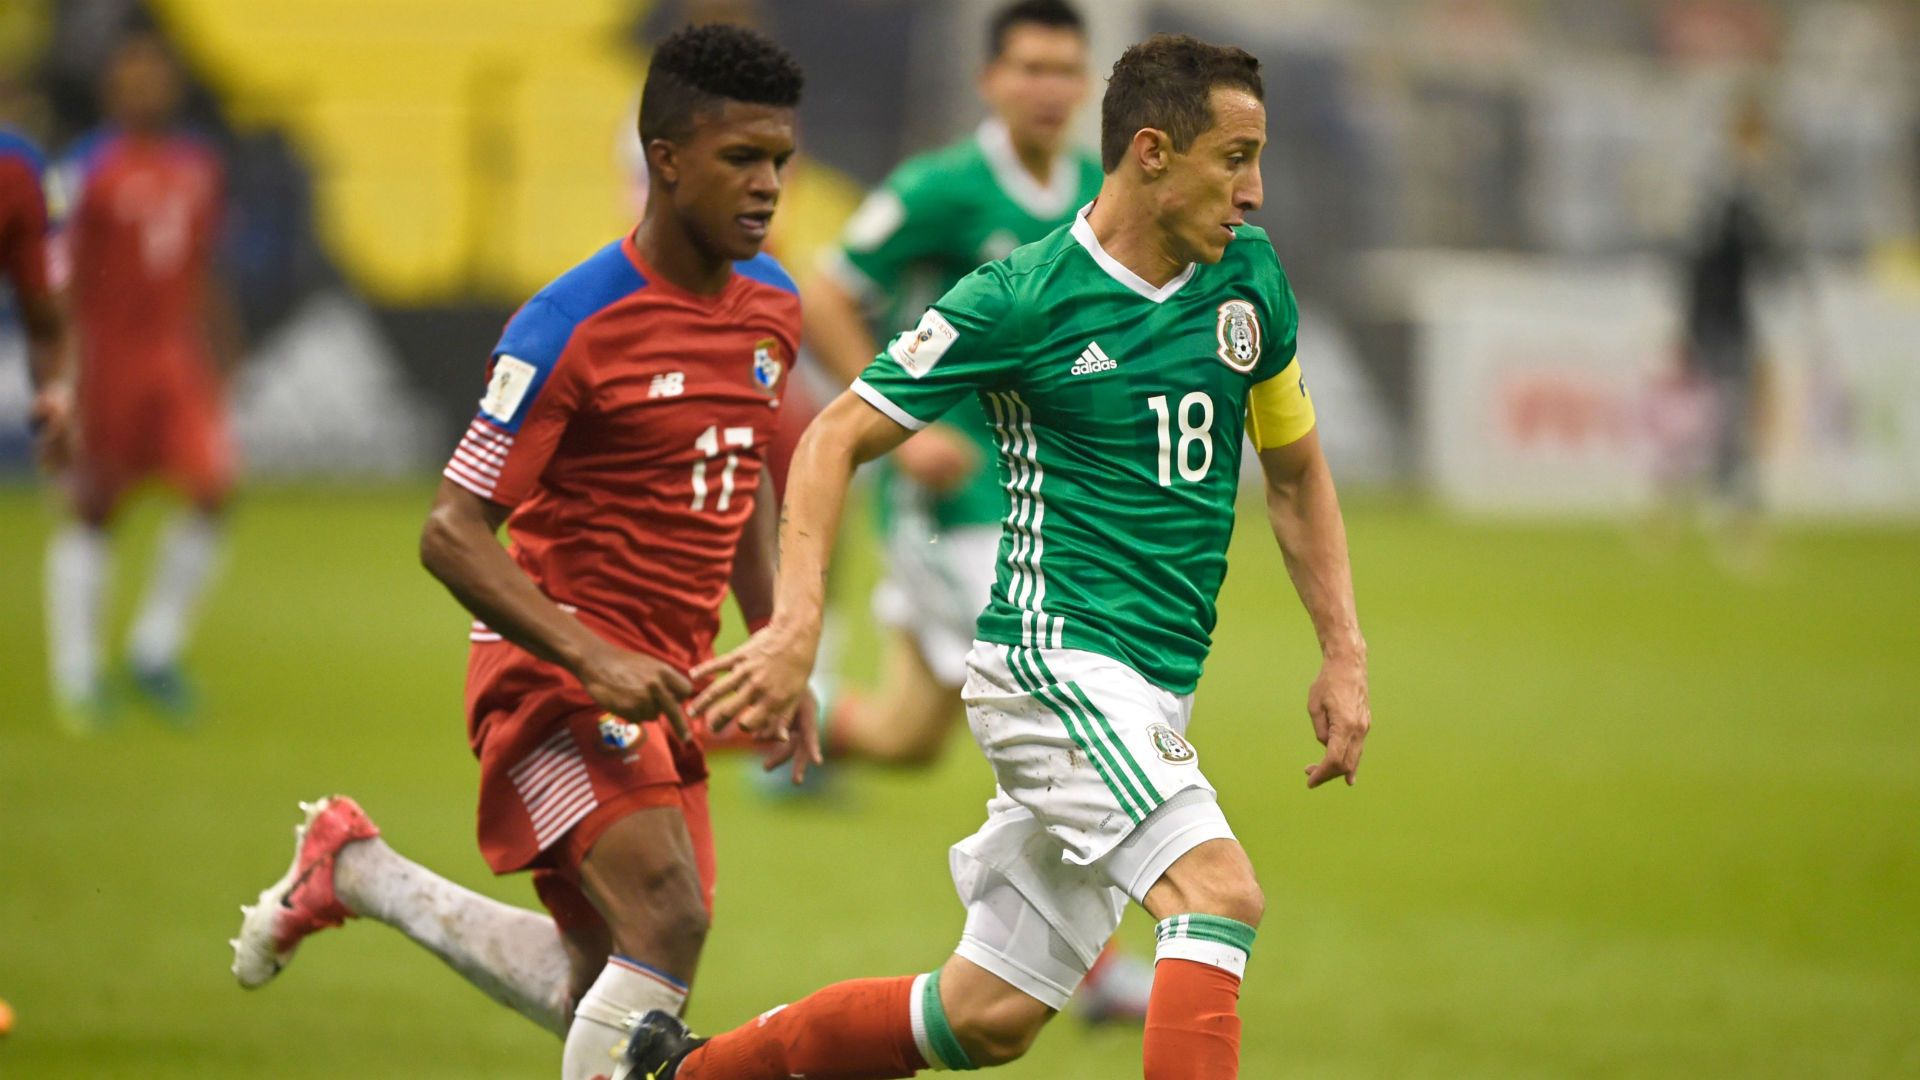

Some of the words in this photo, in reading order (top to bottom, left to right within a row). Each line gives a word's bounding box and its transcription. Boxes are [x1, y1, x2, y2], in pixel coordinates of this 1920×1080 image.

[1071, 358, 1117, 376] adidas
[691, 425, 754, 512] 17
[1148, 391, 1214, 487] 18
